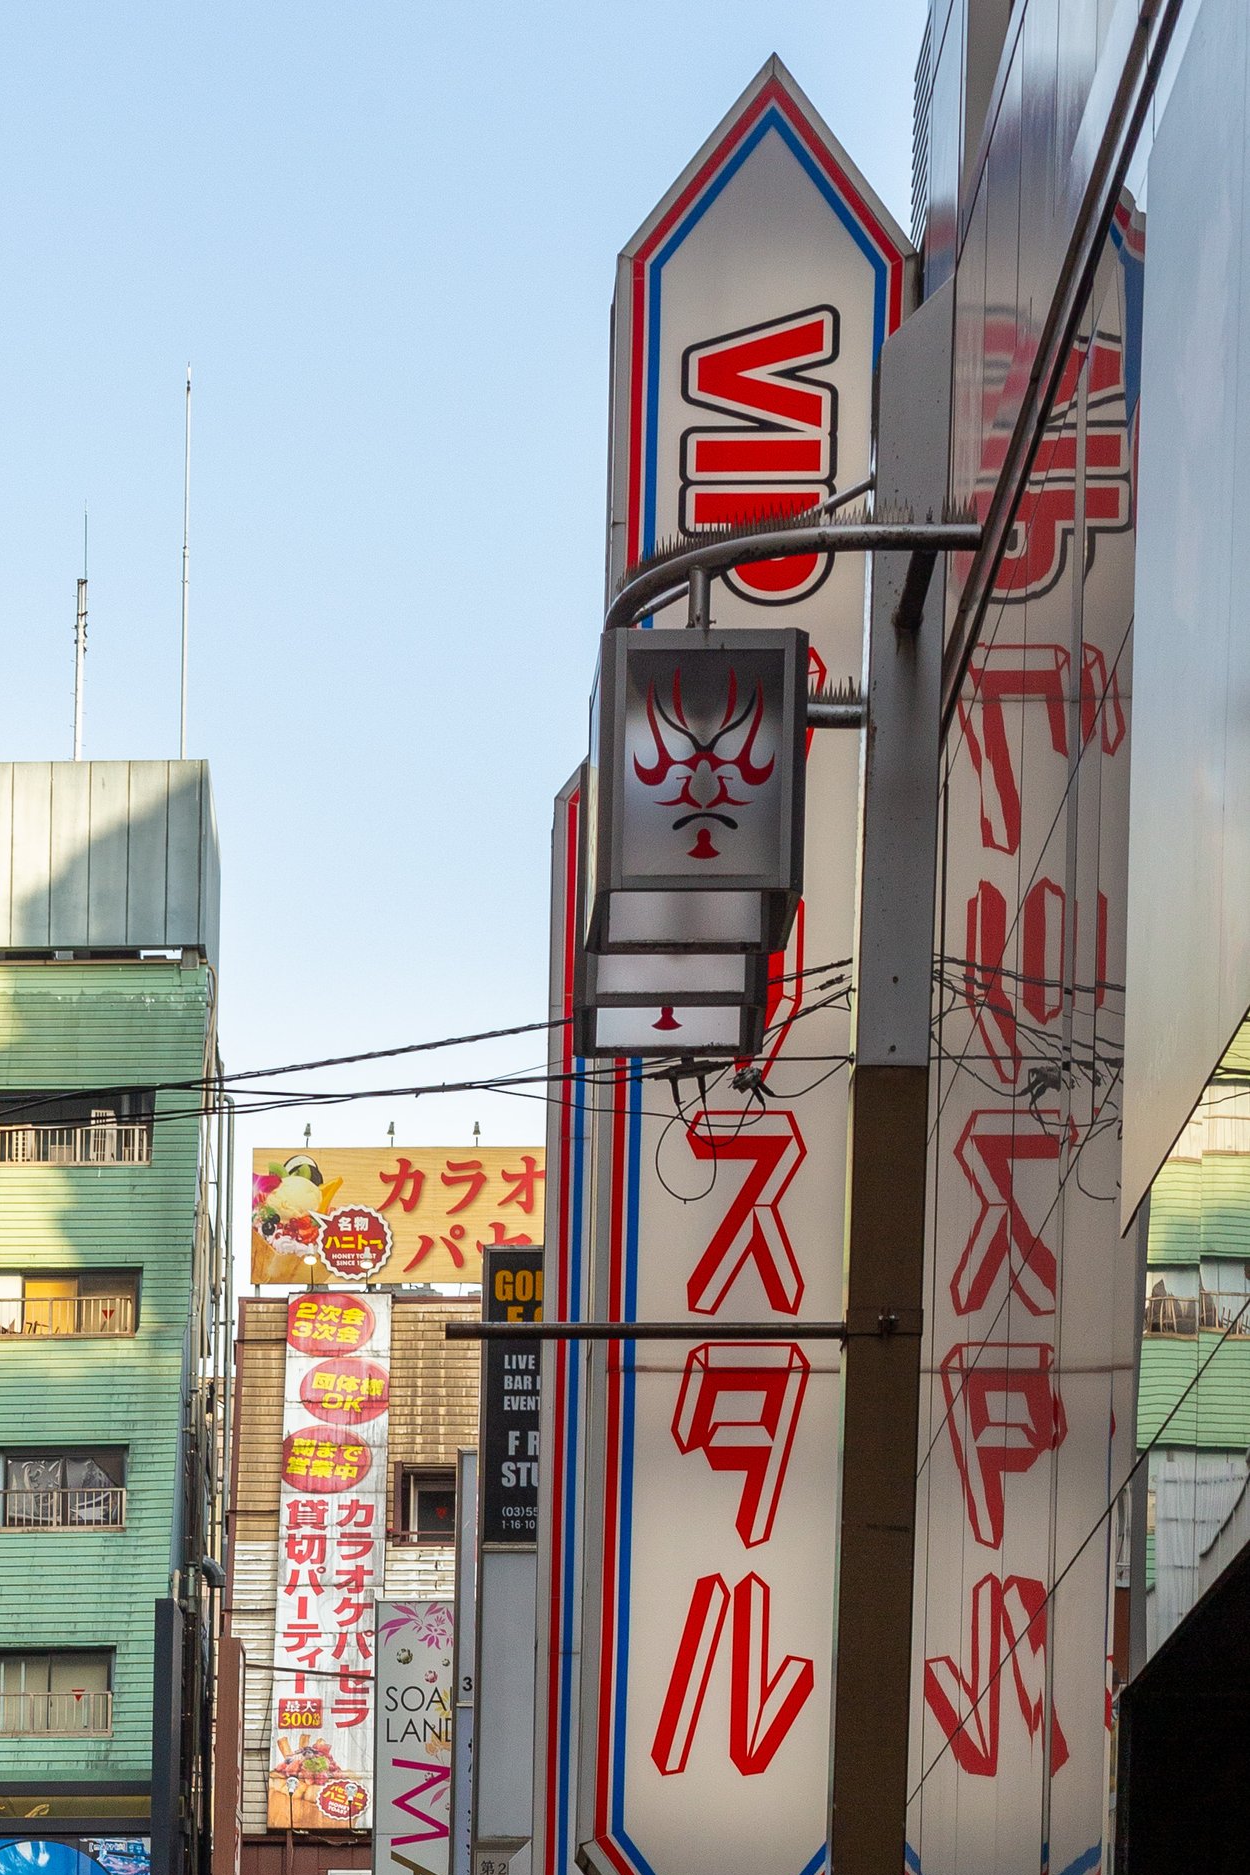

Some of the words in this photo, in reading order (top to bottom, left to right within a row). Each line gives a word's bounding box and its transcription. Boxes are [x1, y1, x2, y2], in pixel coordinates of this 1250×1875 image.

[681, 304, 841, 605] VIP
[338, 1217, 369, 1232] 名物
[295, 1303, 368, 1326] 2次会
[291, 1321, 362, 1345] 3次会
[504, 1355, 535, 1370] LIVE
[311, 1371, 385, 1397] 団体様
[504, 1375, 532, 1391] BAR
[321, 1392, 363, 1413] OK
[291, 1437, 363, 1462] 朝まで
[285, 1455, 359, 1482] 営業中
[283, 1499, 329, 1694] 貸切パーティー
[330, 1499, 375, 1729] カラオケパセラ
[285, 1700, 318, 1712] 最大
[384, 1686, 454, 1713] SOA
